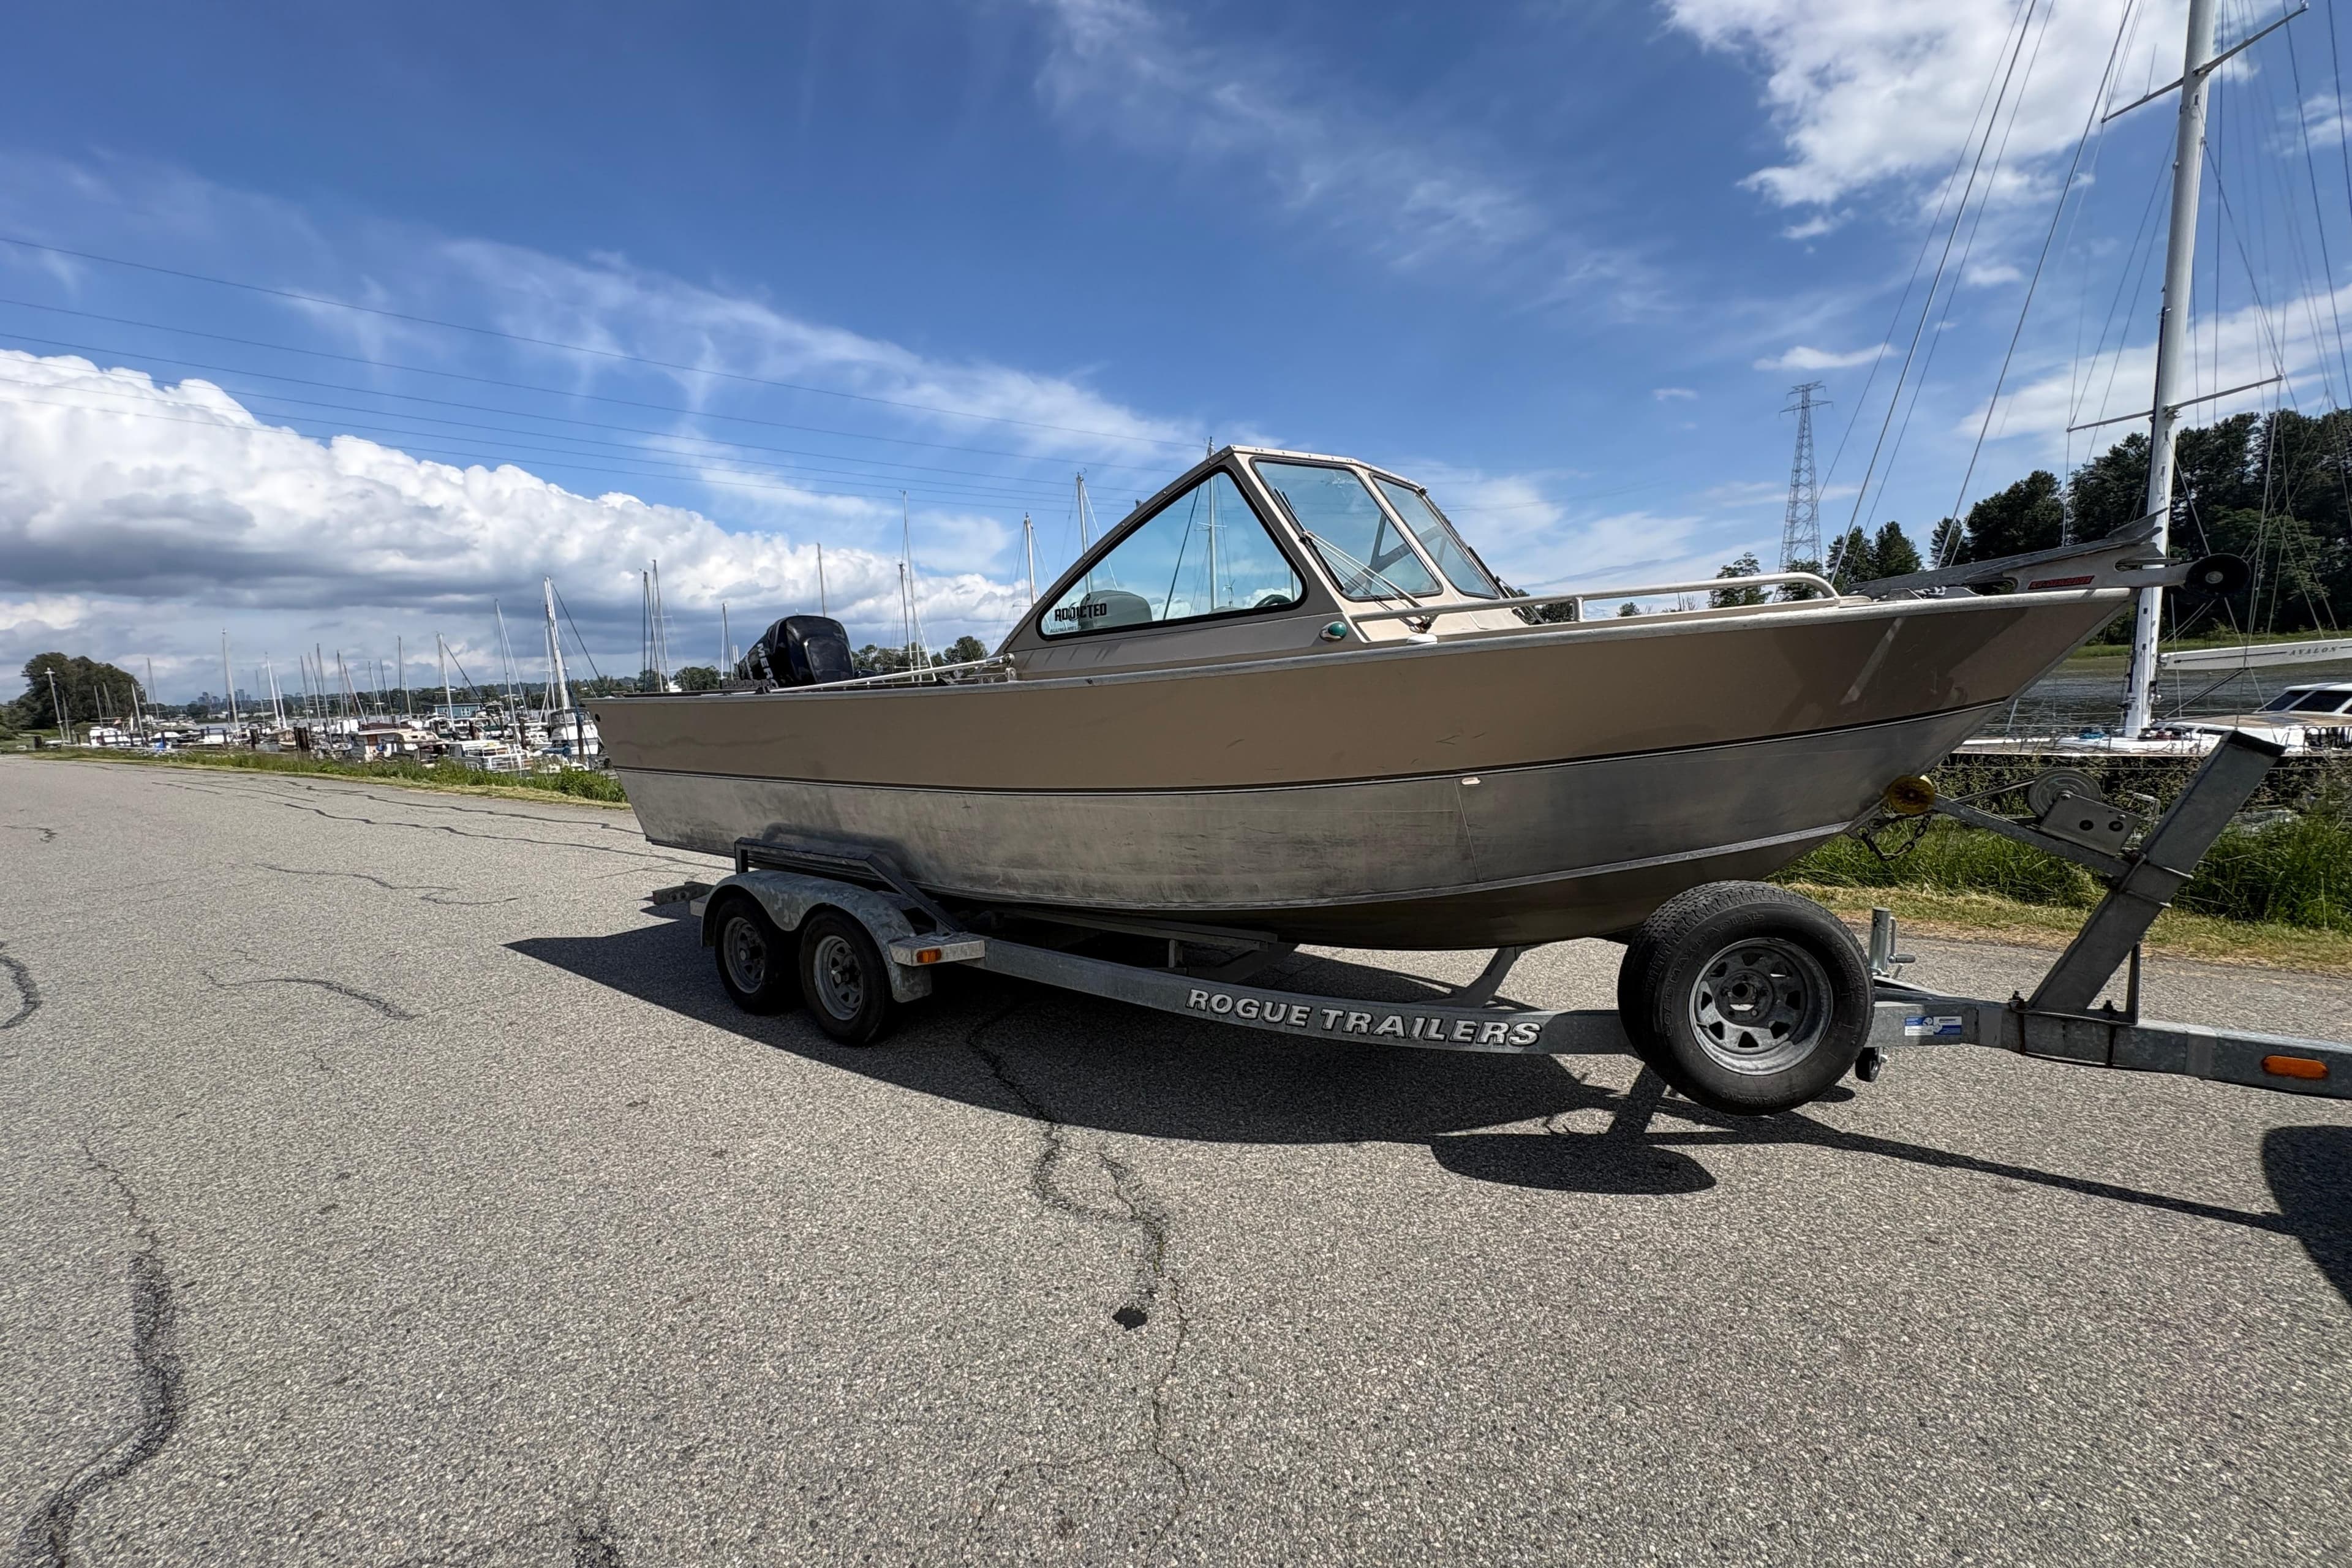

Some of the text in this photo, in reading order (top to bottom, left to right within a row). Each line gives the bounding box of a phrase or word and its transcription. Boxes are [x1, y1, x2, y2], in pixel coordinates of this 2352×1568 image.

[1055, 603, 1106, 622] ADDICTED
[2289, 646, 2337, 655] AVALON
[1186, 988, 1544, 1046] ROGUE TRAILERS
